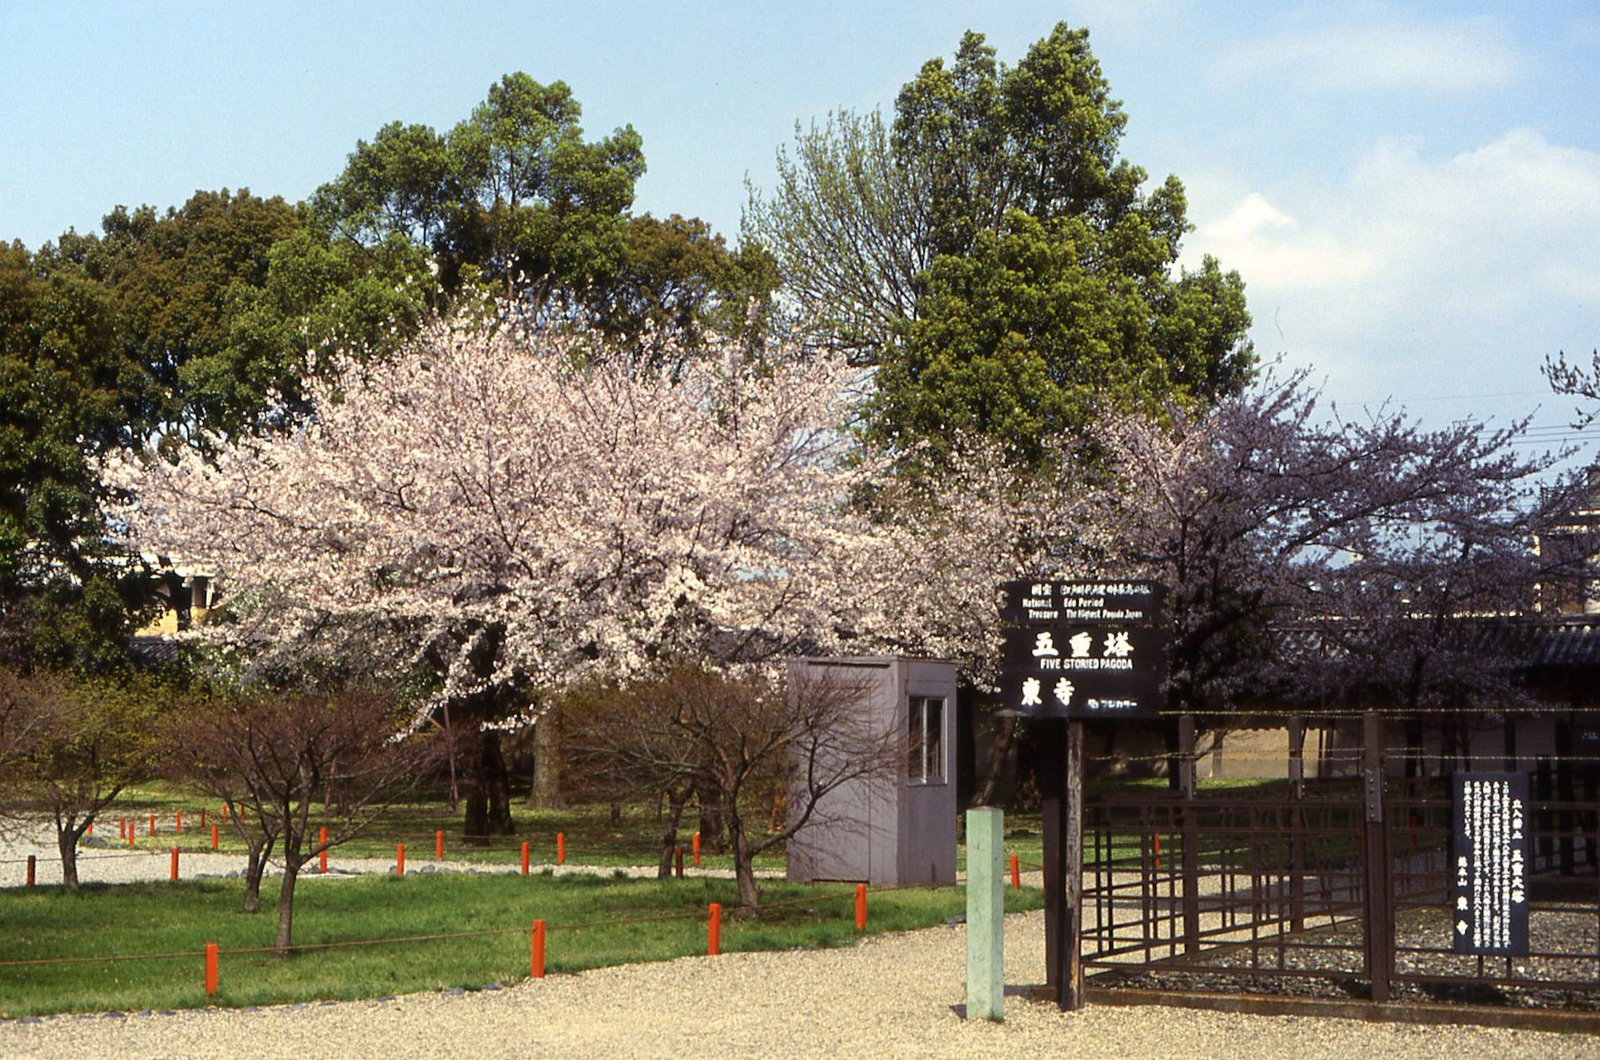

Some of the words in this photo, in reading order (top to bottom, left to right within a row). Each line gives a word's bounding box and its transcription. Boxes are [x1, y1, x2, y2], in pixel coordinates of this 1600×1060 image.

[1063, 598, 1077, 608] Edo
[1078, 598, 1104, 608] Period
[1028, 610, 1059, 619] Treasure
[1032, 631, 1134, 658] 五重塔
[1040, 658, 1061, 670] FIVE
[1063, 658, 1099, 670] STORIED
[1100, 658, 1133, 670] PAGODA
[1021, 676, 1075, 707] 東寺
